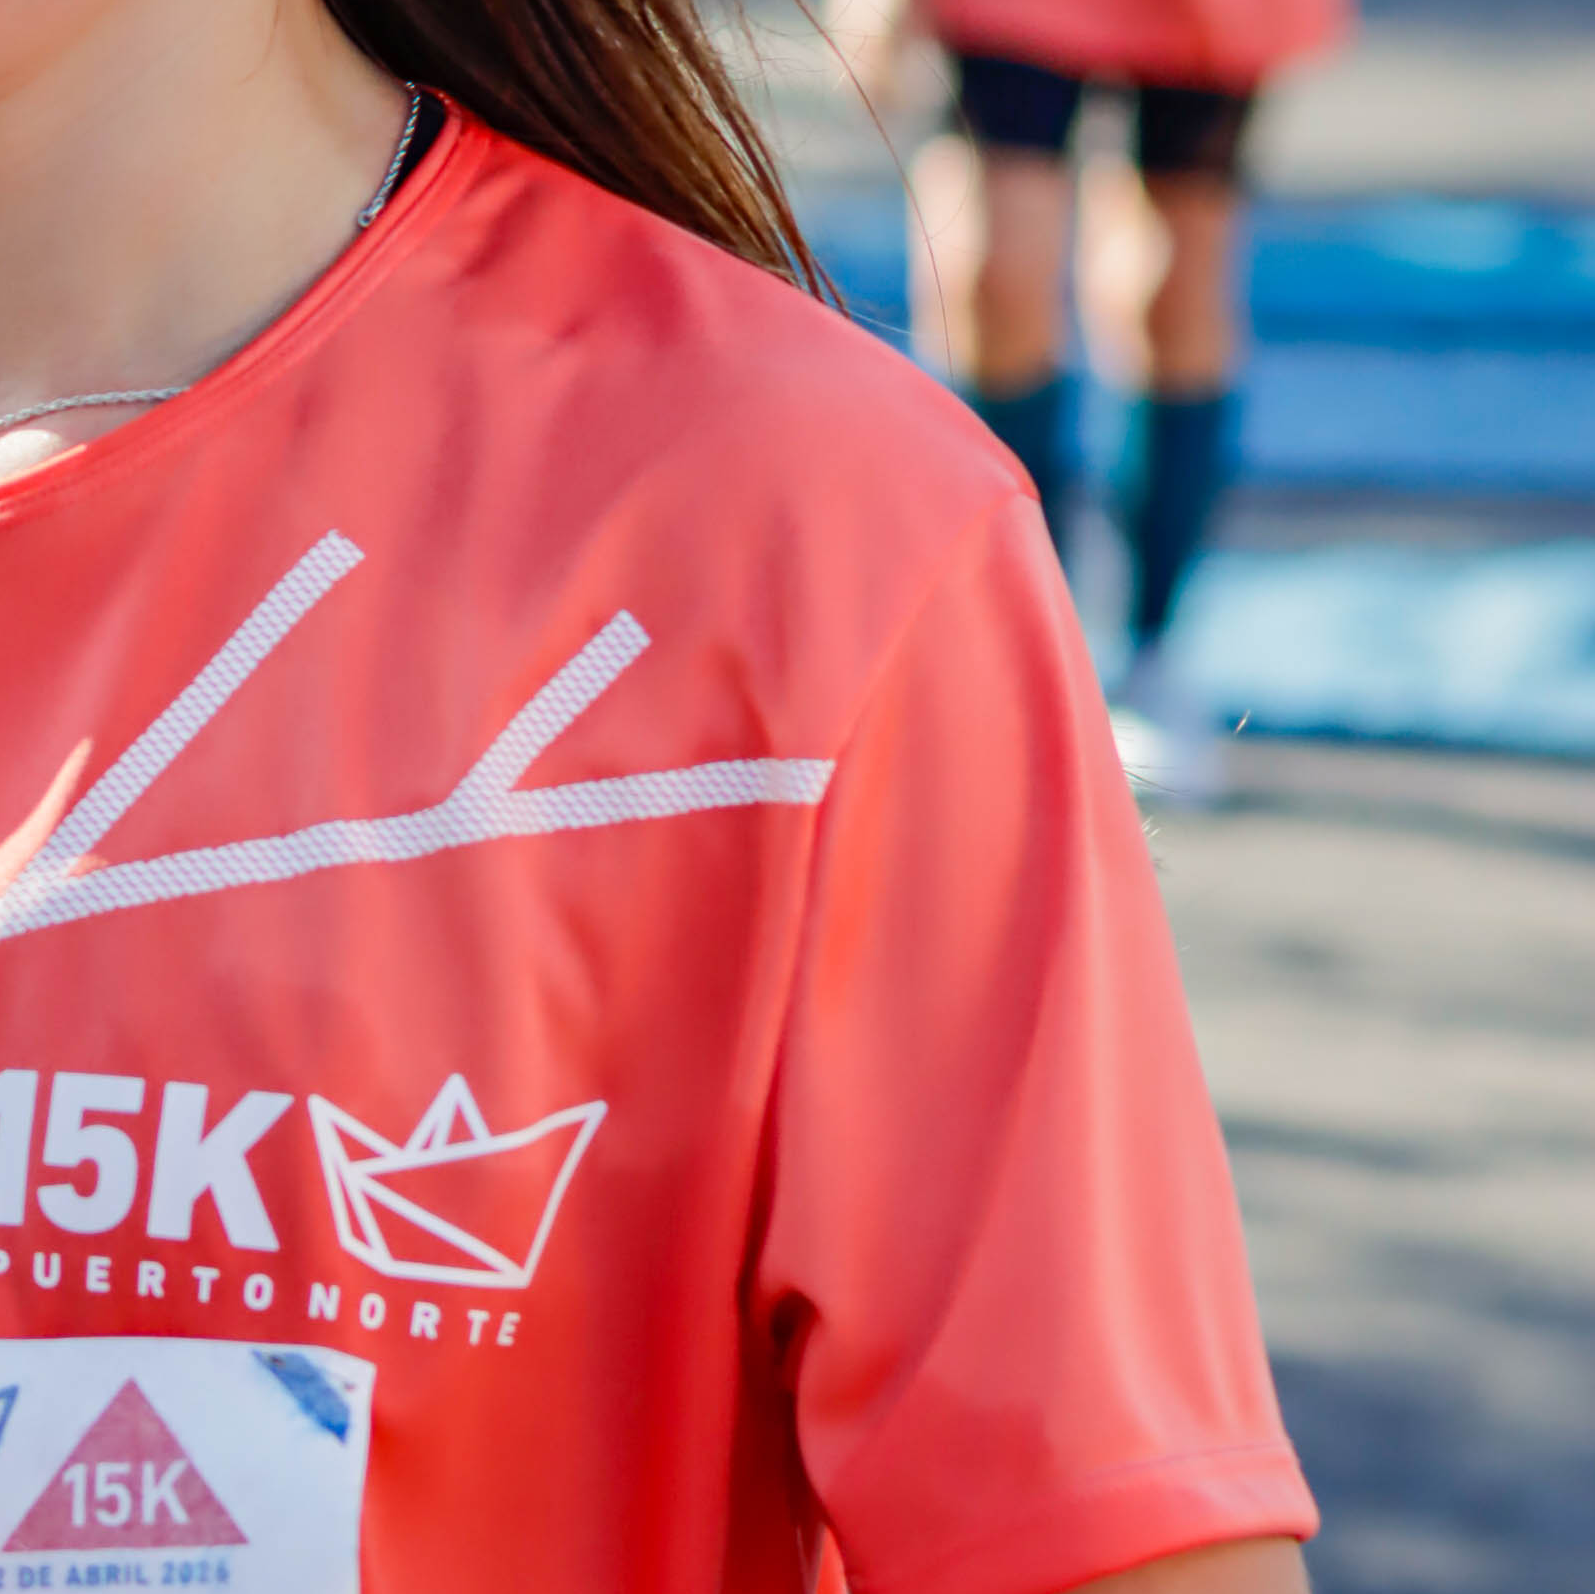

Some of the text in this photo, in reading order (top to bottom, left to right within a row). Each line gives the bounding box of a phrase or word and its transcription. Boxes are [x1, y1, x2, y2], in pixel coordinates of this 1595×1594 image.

[308, 1283, 523, 1347] NORTE
[61, 1458, 191, 1529] 15K
[18, 1564, 53, 1589] DE
[65, 1561, 149, 1588] ABRIL
[161, 1559, 231, 1587] 2026
